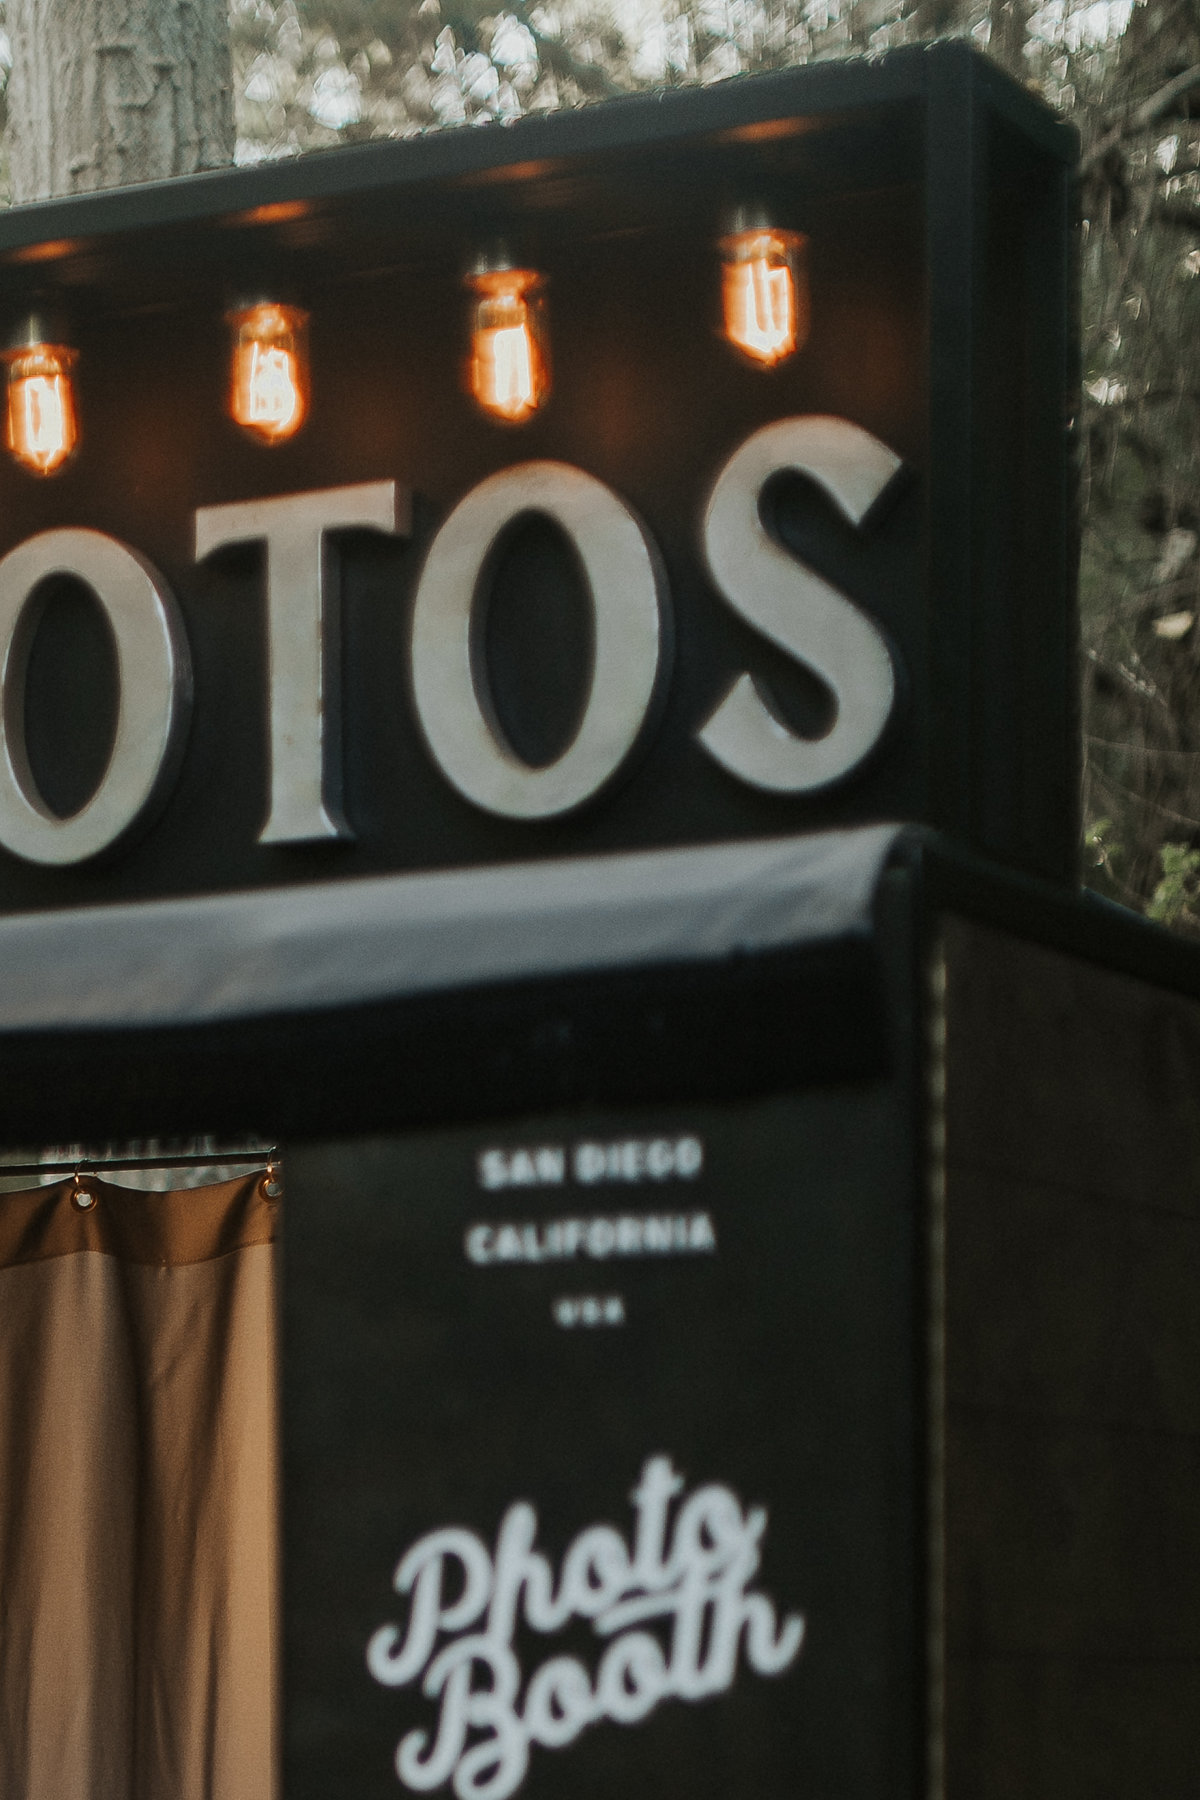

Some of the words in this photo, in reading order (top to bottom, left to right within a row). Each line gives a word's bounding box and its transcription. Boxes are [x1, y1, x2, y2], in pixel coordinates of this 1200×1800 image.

[477, 1145, 566, 1190] SAN
[572, 1134, 704, 1185] DIEGO
[464, 1211, 717, 1266] CALIFORNIA
[366, 1453, 770, 1687] Photo
